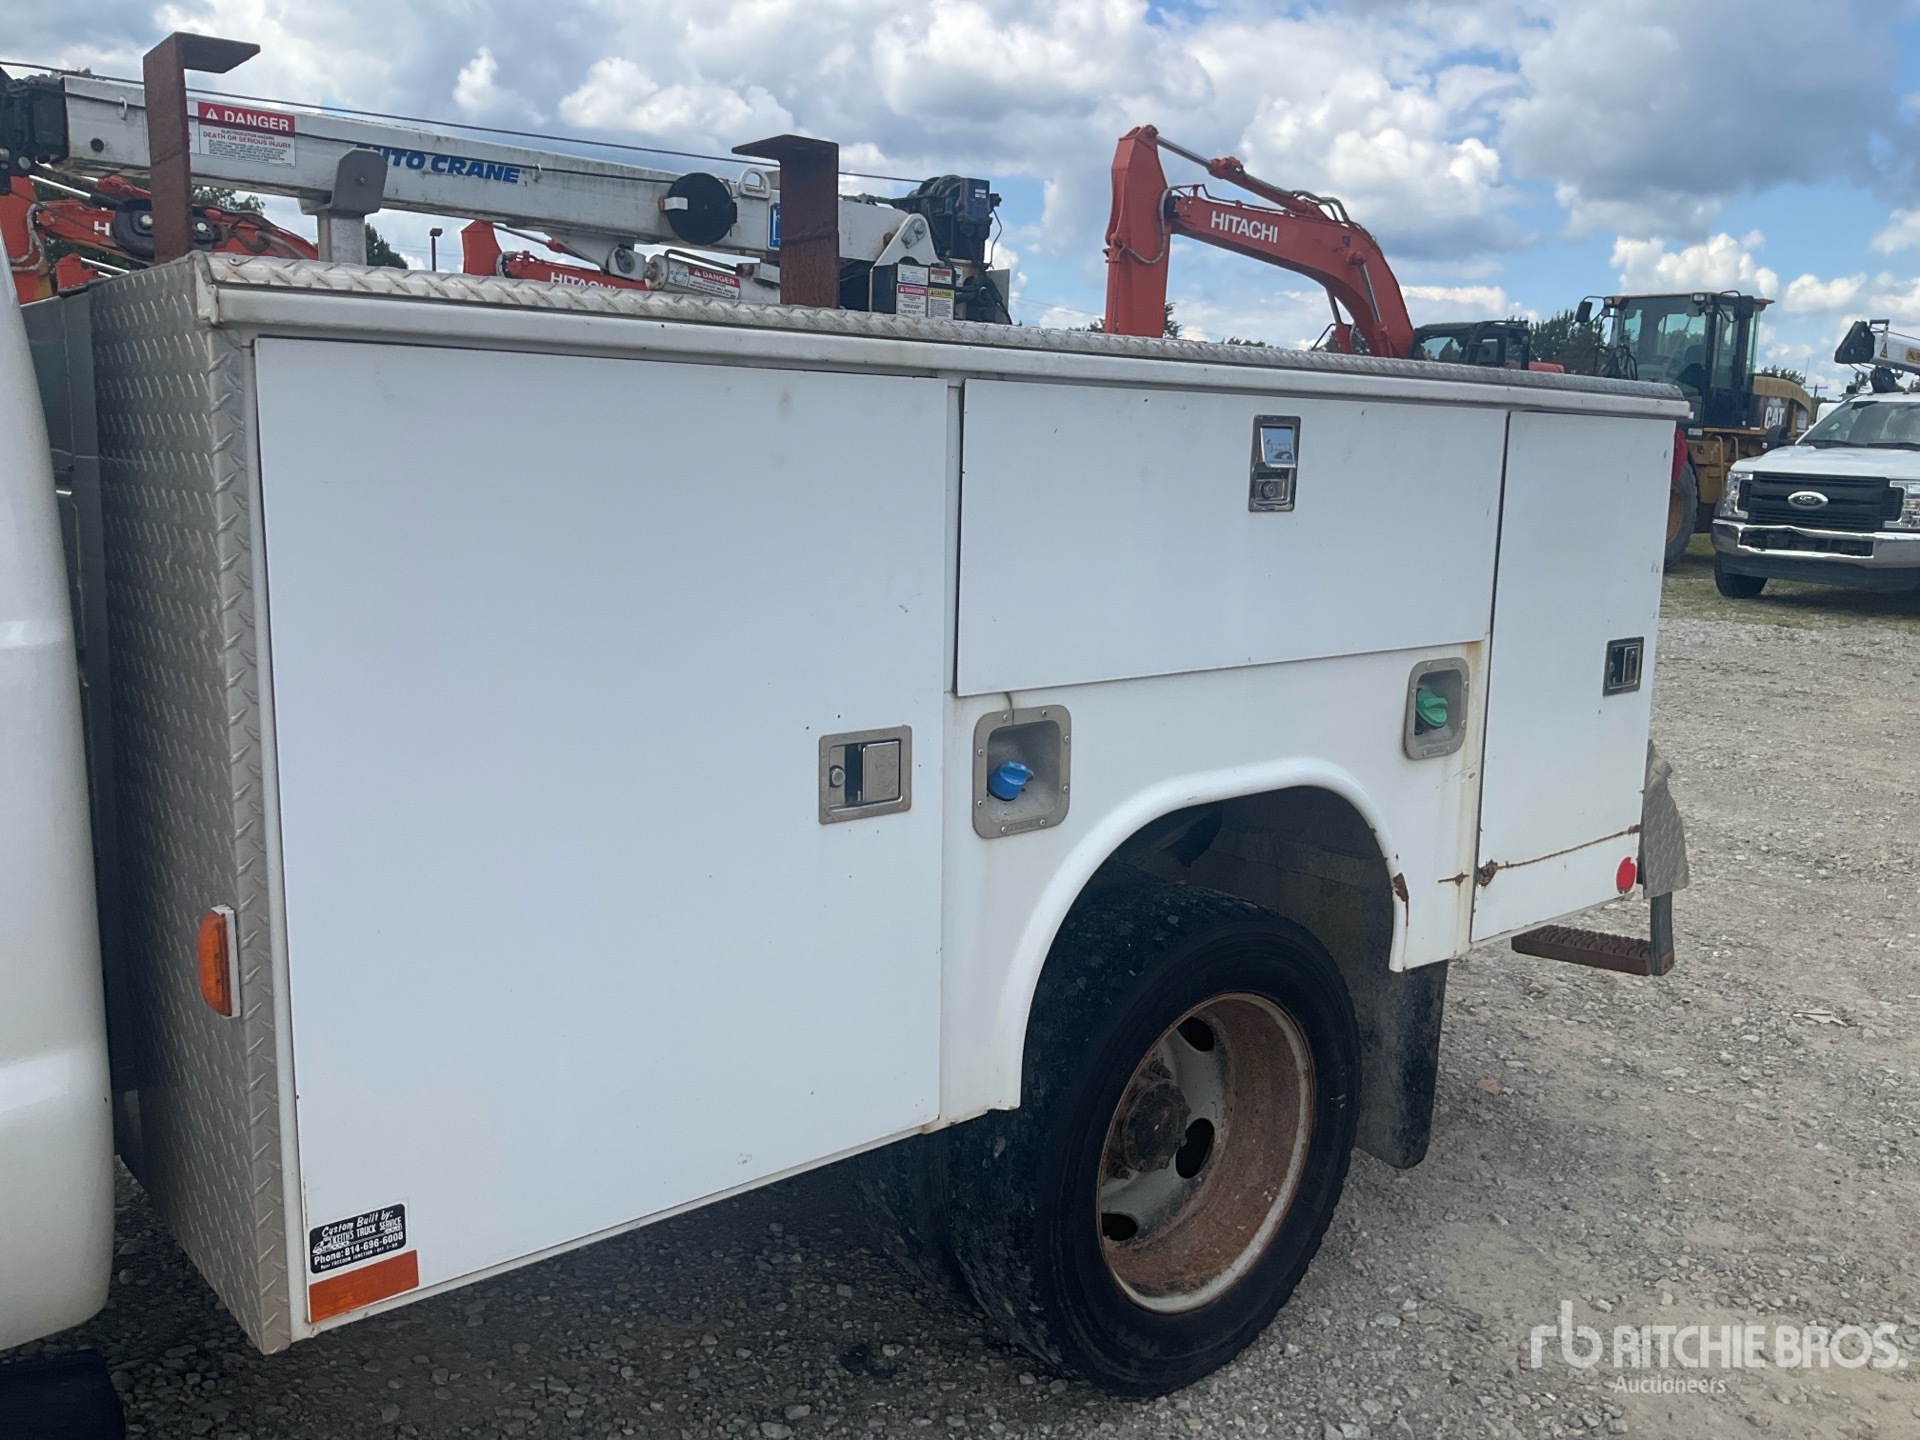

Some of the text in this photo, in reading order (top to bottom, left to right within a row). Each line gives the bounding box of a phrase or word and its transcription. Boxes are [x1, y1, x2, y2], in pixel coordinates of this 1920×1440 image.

[224, 109, 290, 132] DANGER
[202, 130, 292, 149] DEATH OR SERIOUS INJURY
[430, 153, 521, 184] CRANE
[1210, 210, 1279, 244] HITACHI
[550, 271, 617, 290] HITA
[702, 270, 736, 286] DANGER
[1764, 406, 1786, 430] CAT
[321, 1209, 394, 1238] Custom Built by:
[356, 1222, 377, 1238] TRUCK
[379, 1216, 402, 1231] SERVICE
